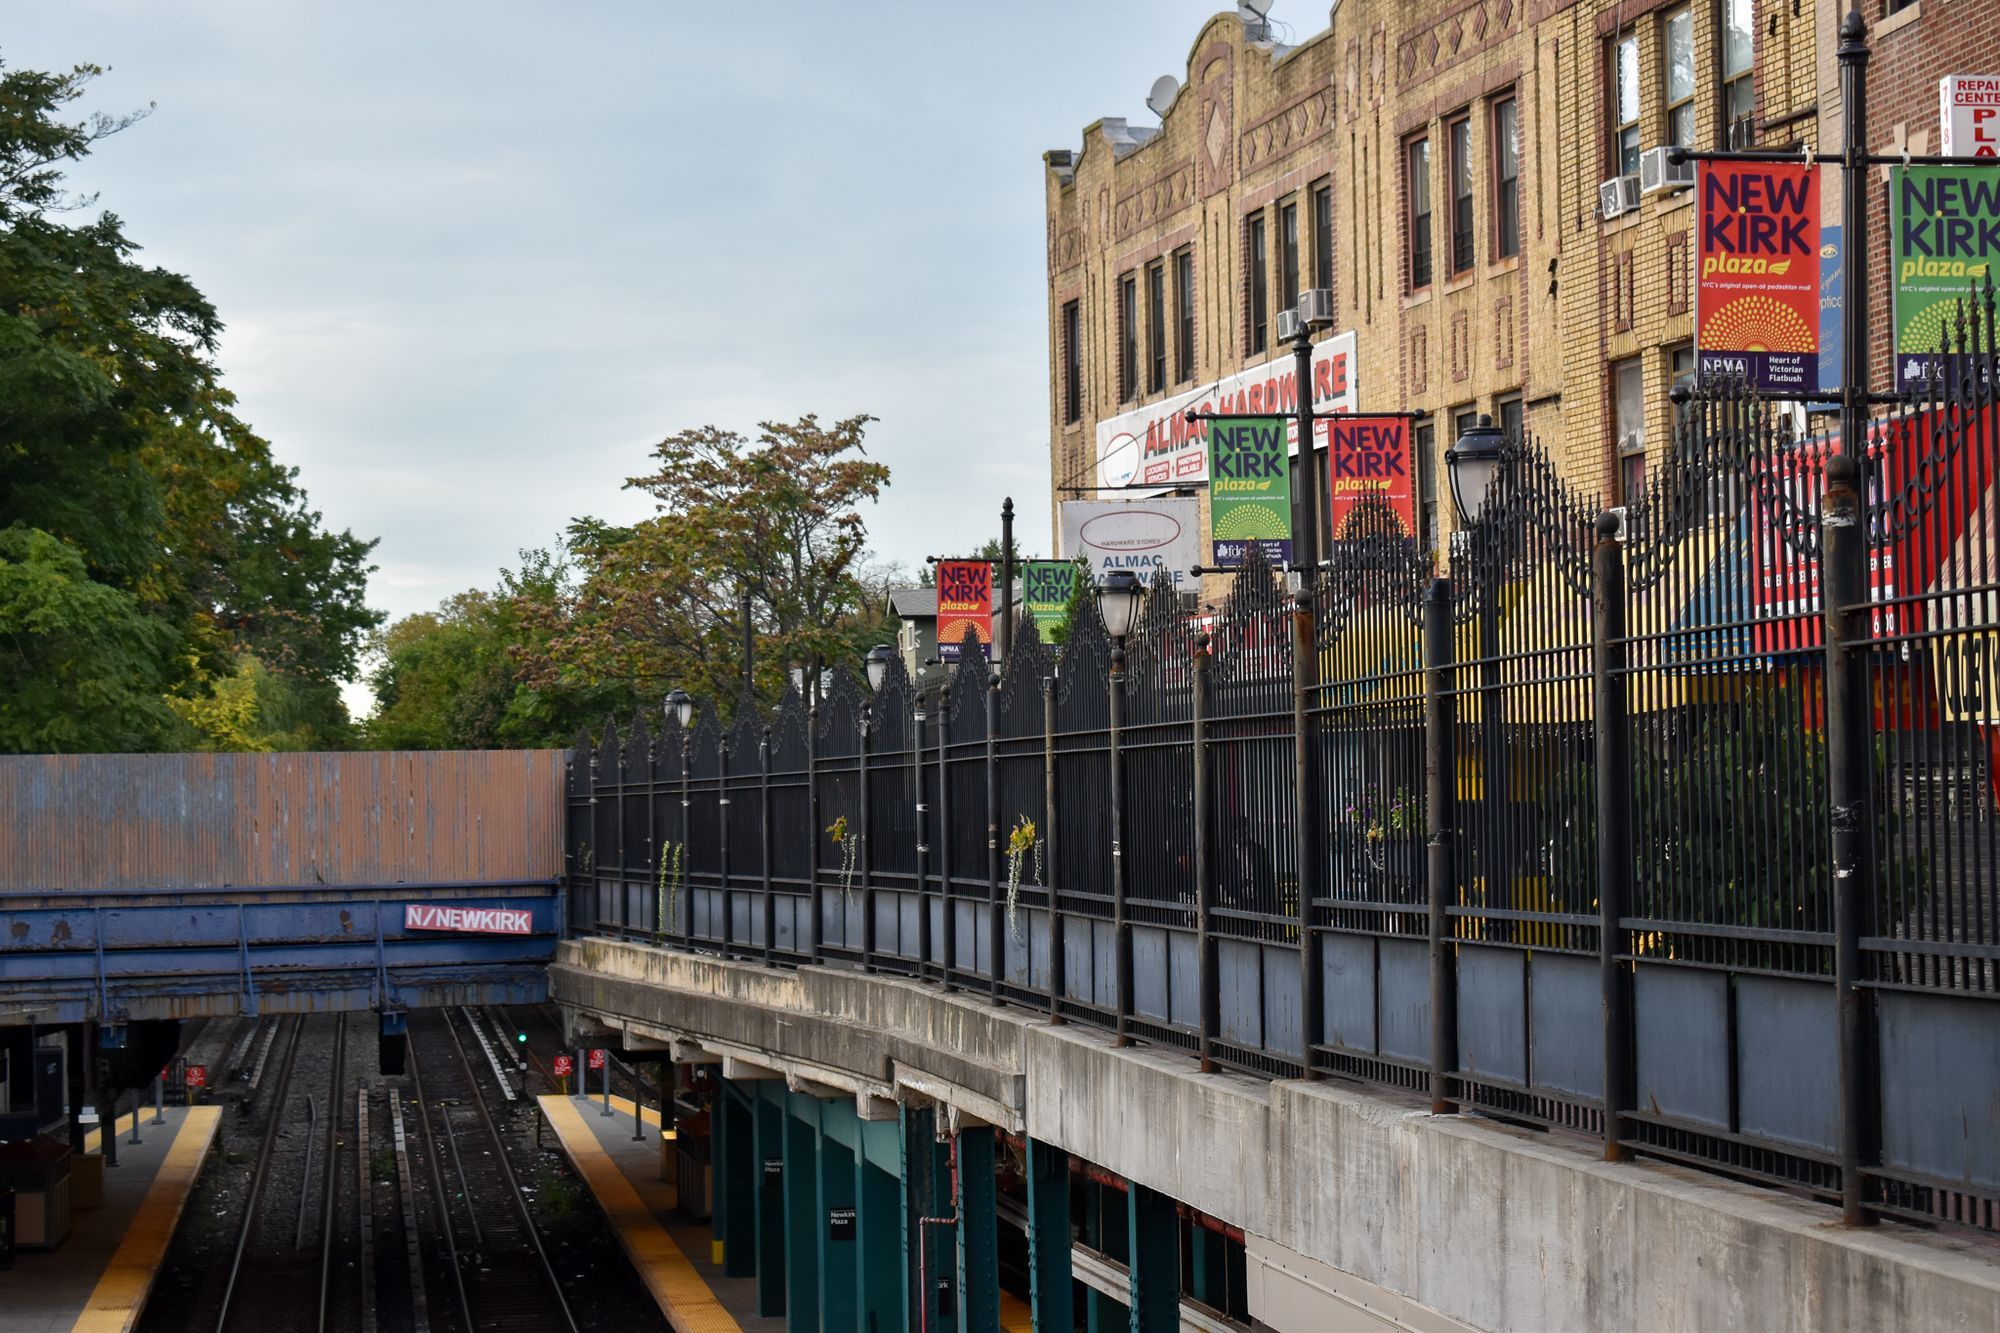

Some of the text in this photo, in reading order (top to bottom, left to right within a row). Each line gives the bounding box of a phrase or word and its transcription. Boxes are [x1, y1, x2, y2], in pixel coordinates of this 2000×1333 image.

[1957, 80, 1999, 91] REPAI
[1954, 92, 2000, 103] CENTE
[1705, 172, 1810, 215] NEW
[1902, 176, 2000, 217] NEW
[1705, 212, 1812, 256] KIRK
[1902, 217, 2000, 257] KIRK
[1702, 251, 1767, 279] plaza
[1901, 255, 1965, 283] plaza
[1769, 356, 1801, 364] Heart of
[1769, 365, 1804, 374] Victorian
[1220, 351, 1348, 416] HARDWRE
[1768, 375, 1802, 383] Flatbush
[1213, 426, 1281, 452] NEW
[1334, 425, 1402, 452] NEW
[1214, 452, 1284, 478] KIRK
[1335, 451, 1405, 478] KIRK
[1214, 477, 1256, 495] plaza
[1102, 554, 1163, 568] ALMAC
[941, 567, 987, 584] NEW
[1027, 567, 1073, 585] NEW
[941, 584, 988, 602] KIRK
[1027, 585, 1072, 603] KIRK
[940, 601, 969, 613] plaza
[408, 906, 530, 932] N/NEWKIRK
